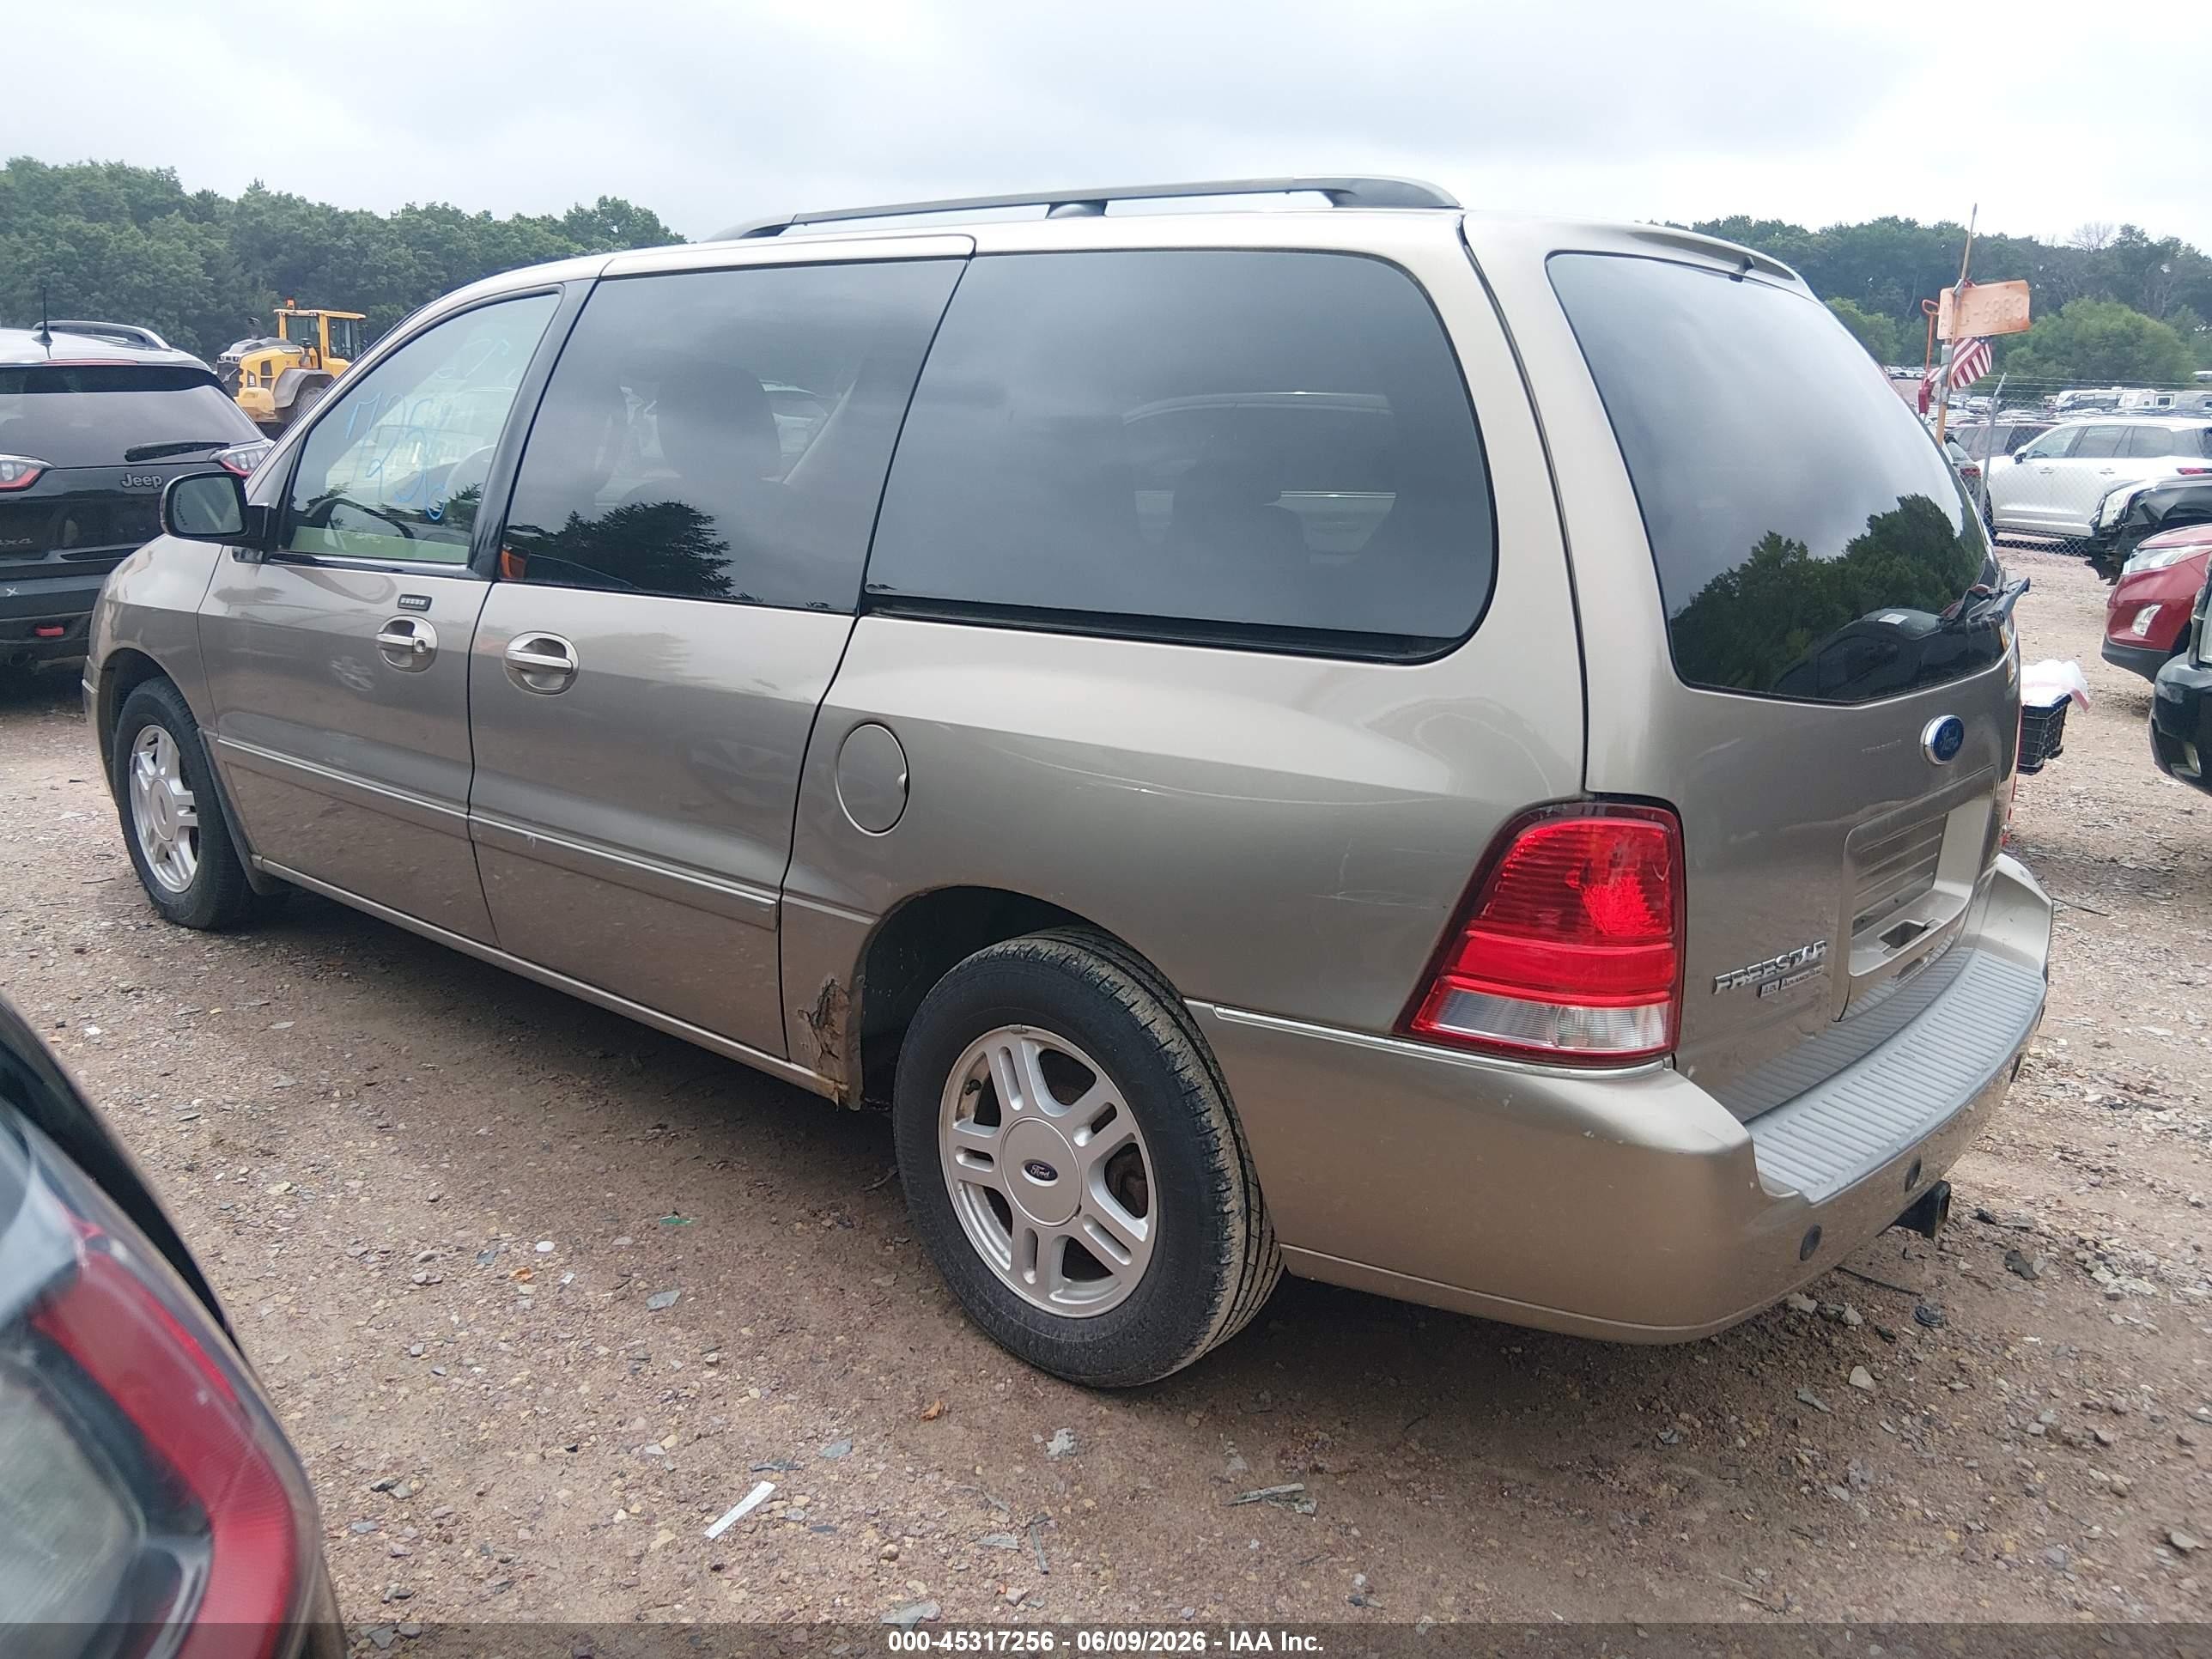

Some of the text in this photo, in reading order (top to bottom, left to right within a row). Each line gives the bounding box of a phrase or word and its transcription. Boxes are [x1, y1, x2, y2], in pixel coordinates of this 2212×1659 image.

[121, 473, 162, 489] Jeep
[1712, 940, 1827, 995] FREESTAR
[1030, 1164, 1051, 1177] Ford
